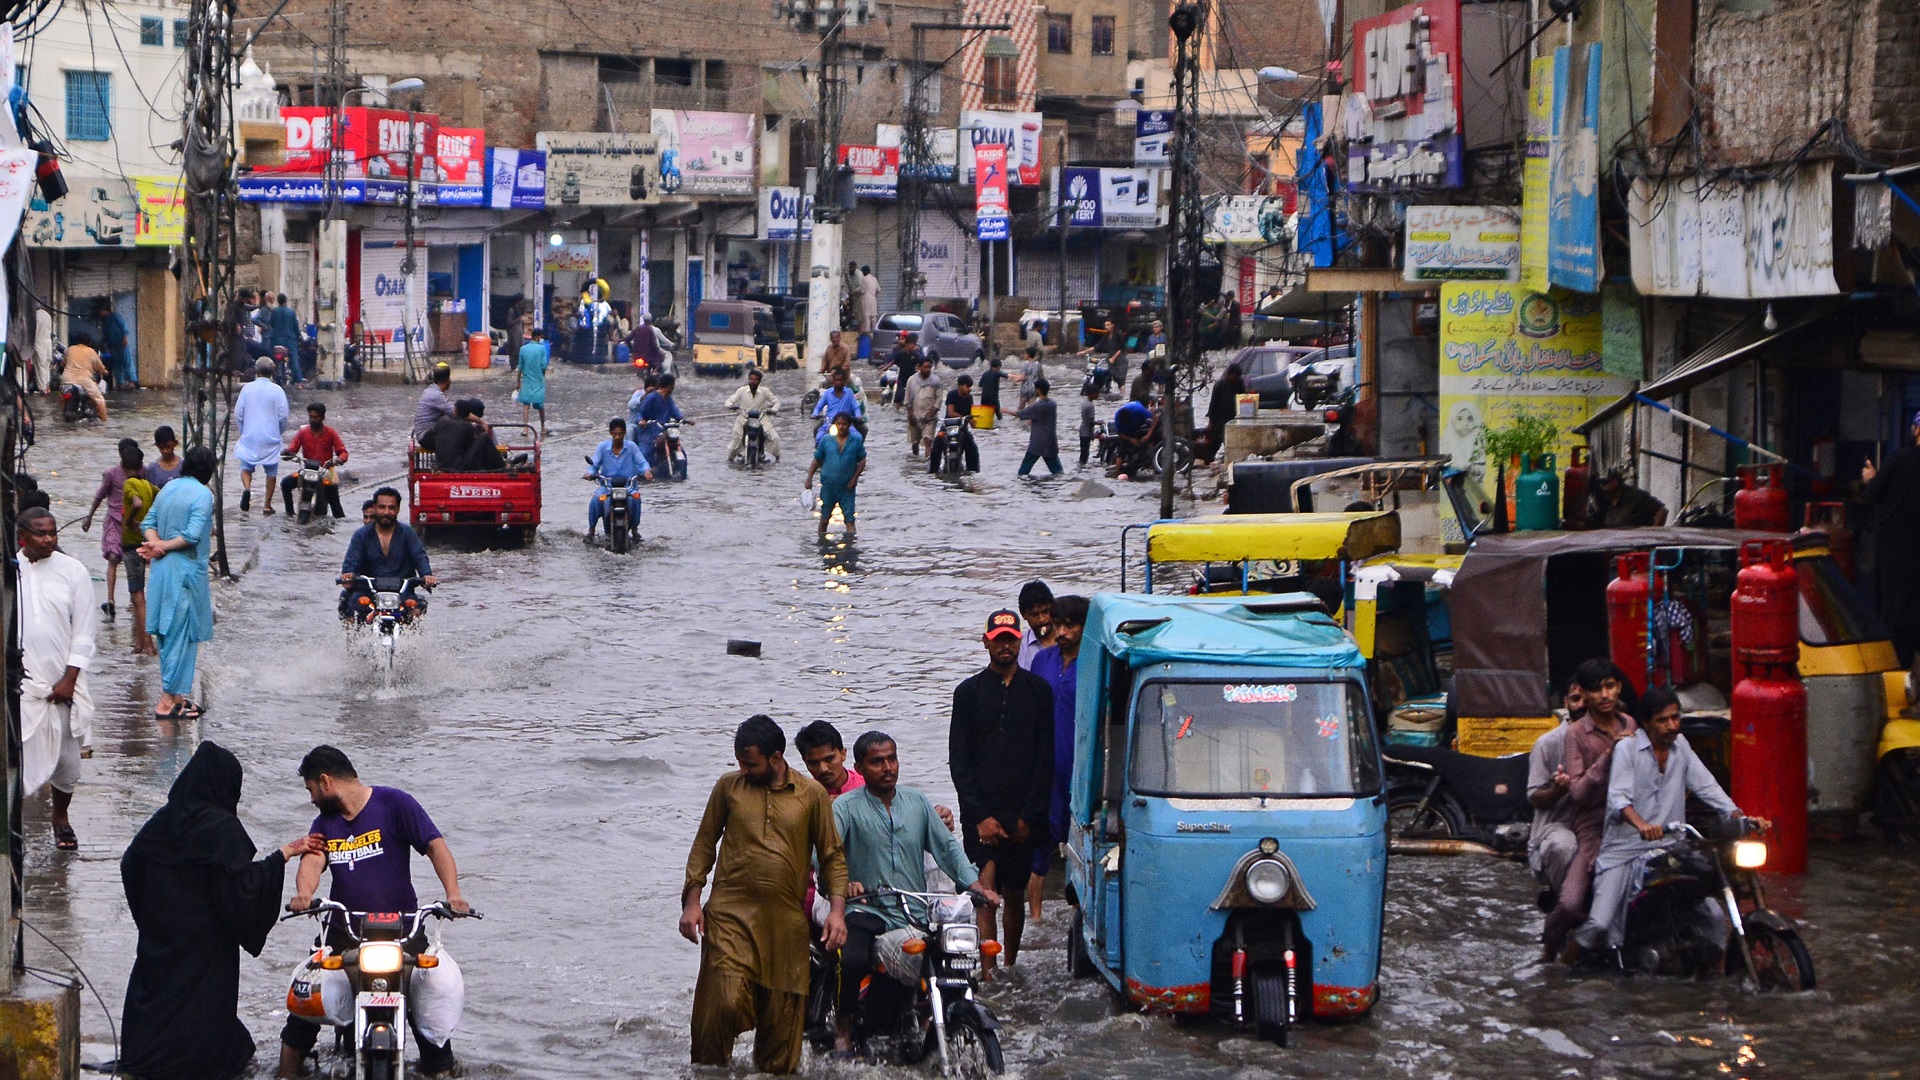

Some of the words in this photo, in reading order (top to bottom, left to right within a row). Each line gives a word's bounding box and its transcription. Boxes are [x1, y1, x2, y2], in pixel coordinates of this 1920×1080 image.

[378, 118, 424, 153] EXIE
[437, 134, 471, 157] EXIDE
[971, 126, 1015, 151] OSAKA
[848, 147, 880, 167] EXIDE
[977, 149, 1003, 158] EXIDE
[920, 240, 948, 259] OSAKA
[375, 273, 406, 296] OSAK
[1448, 291, 1469, 317] ہیں
[1467, 289, 1492, 317] جاری
[1471, 377, 1492, 391] ساتھ
[450, 485, 501, 498] SPEED
[326, 840, 338, 852] OS
[338, 832, 382, 851] ANGELES
[327, 842, 384, 862] ASKETBALL
